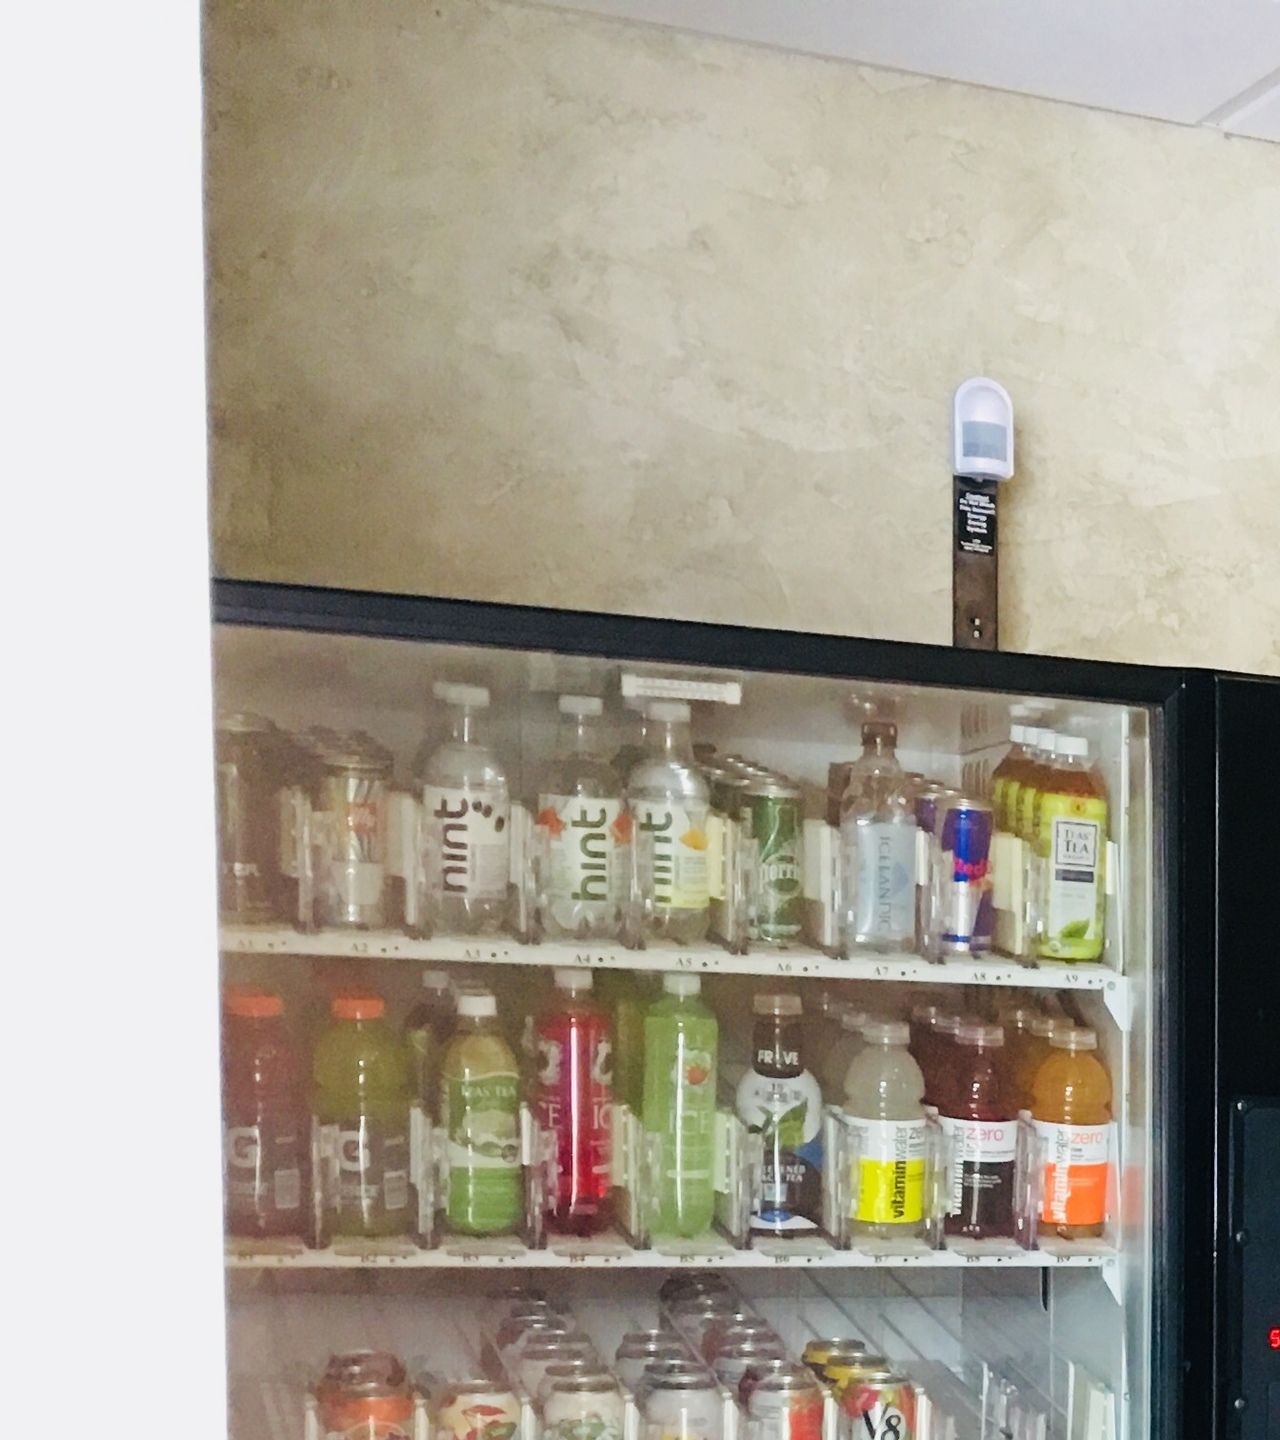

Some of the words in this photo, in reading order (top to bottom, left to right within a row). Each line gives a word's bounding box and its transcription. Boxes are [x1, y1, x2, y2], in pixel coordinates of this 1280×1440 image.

[571, 806, 607, 901] hint
[966, 1127, 1004, 1142] zero
[1072, 1131, 1103, 1145] zero
[341, 1131, 370, 1171] G
